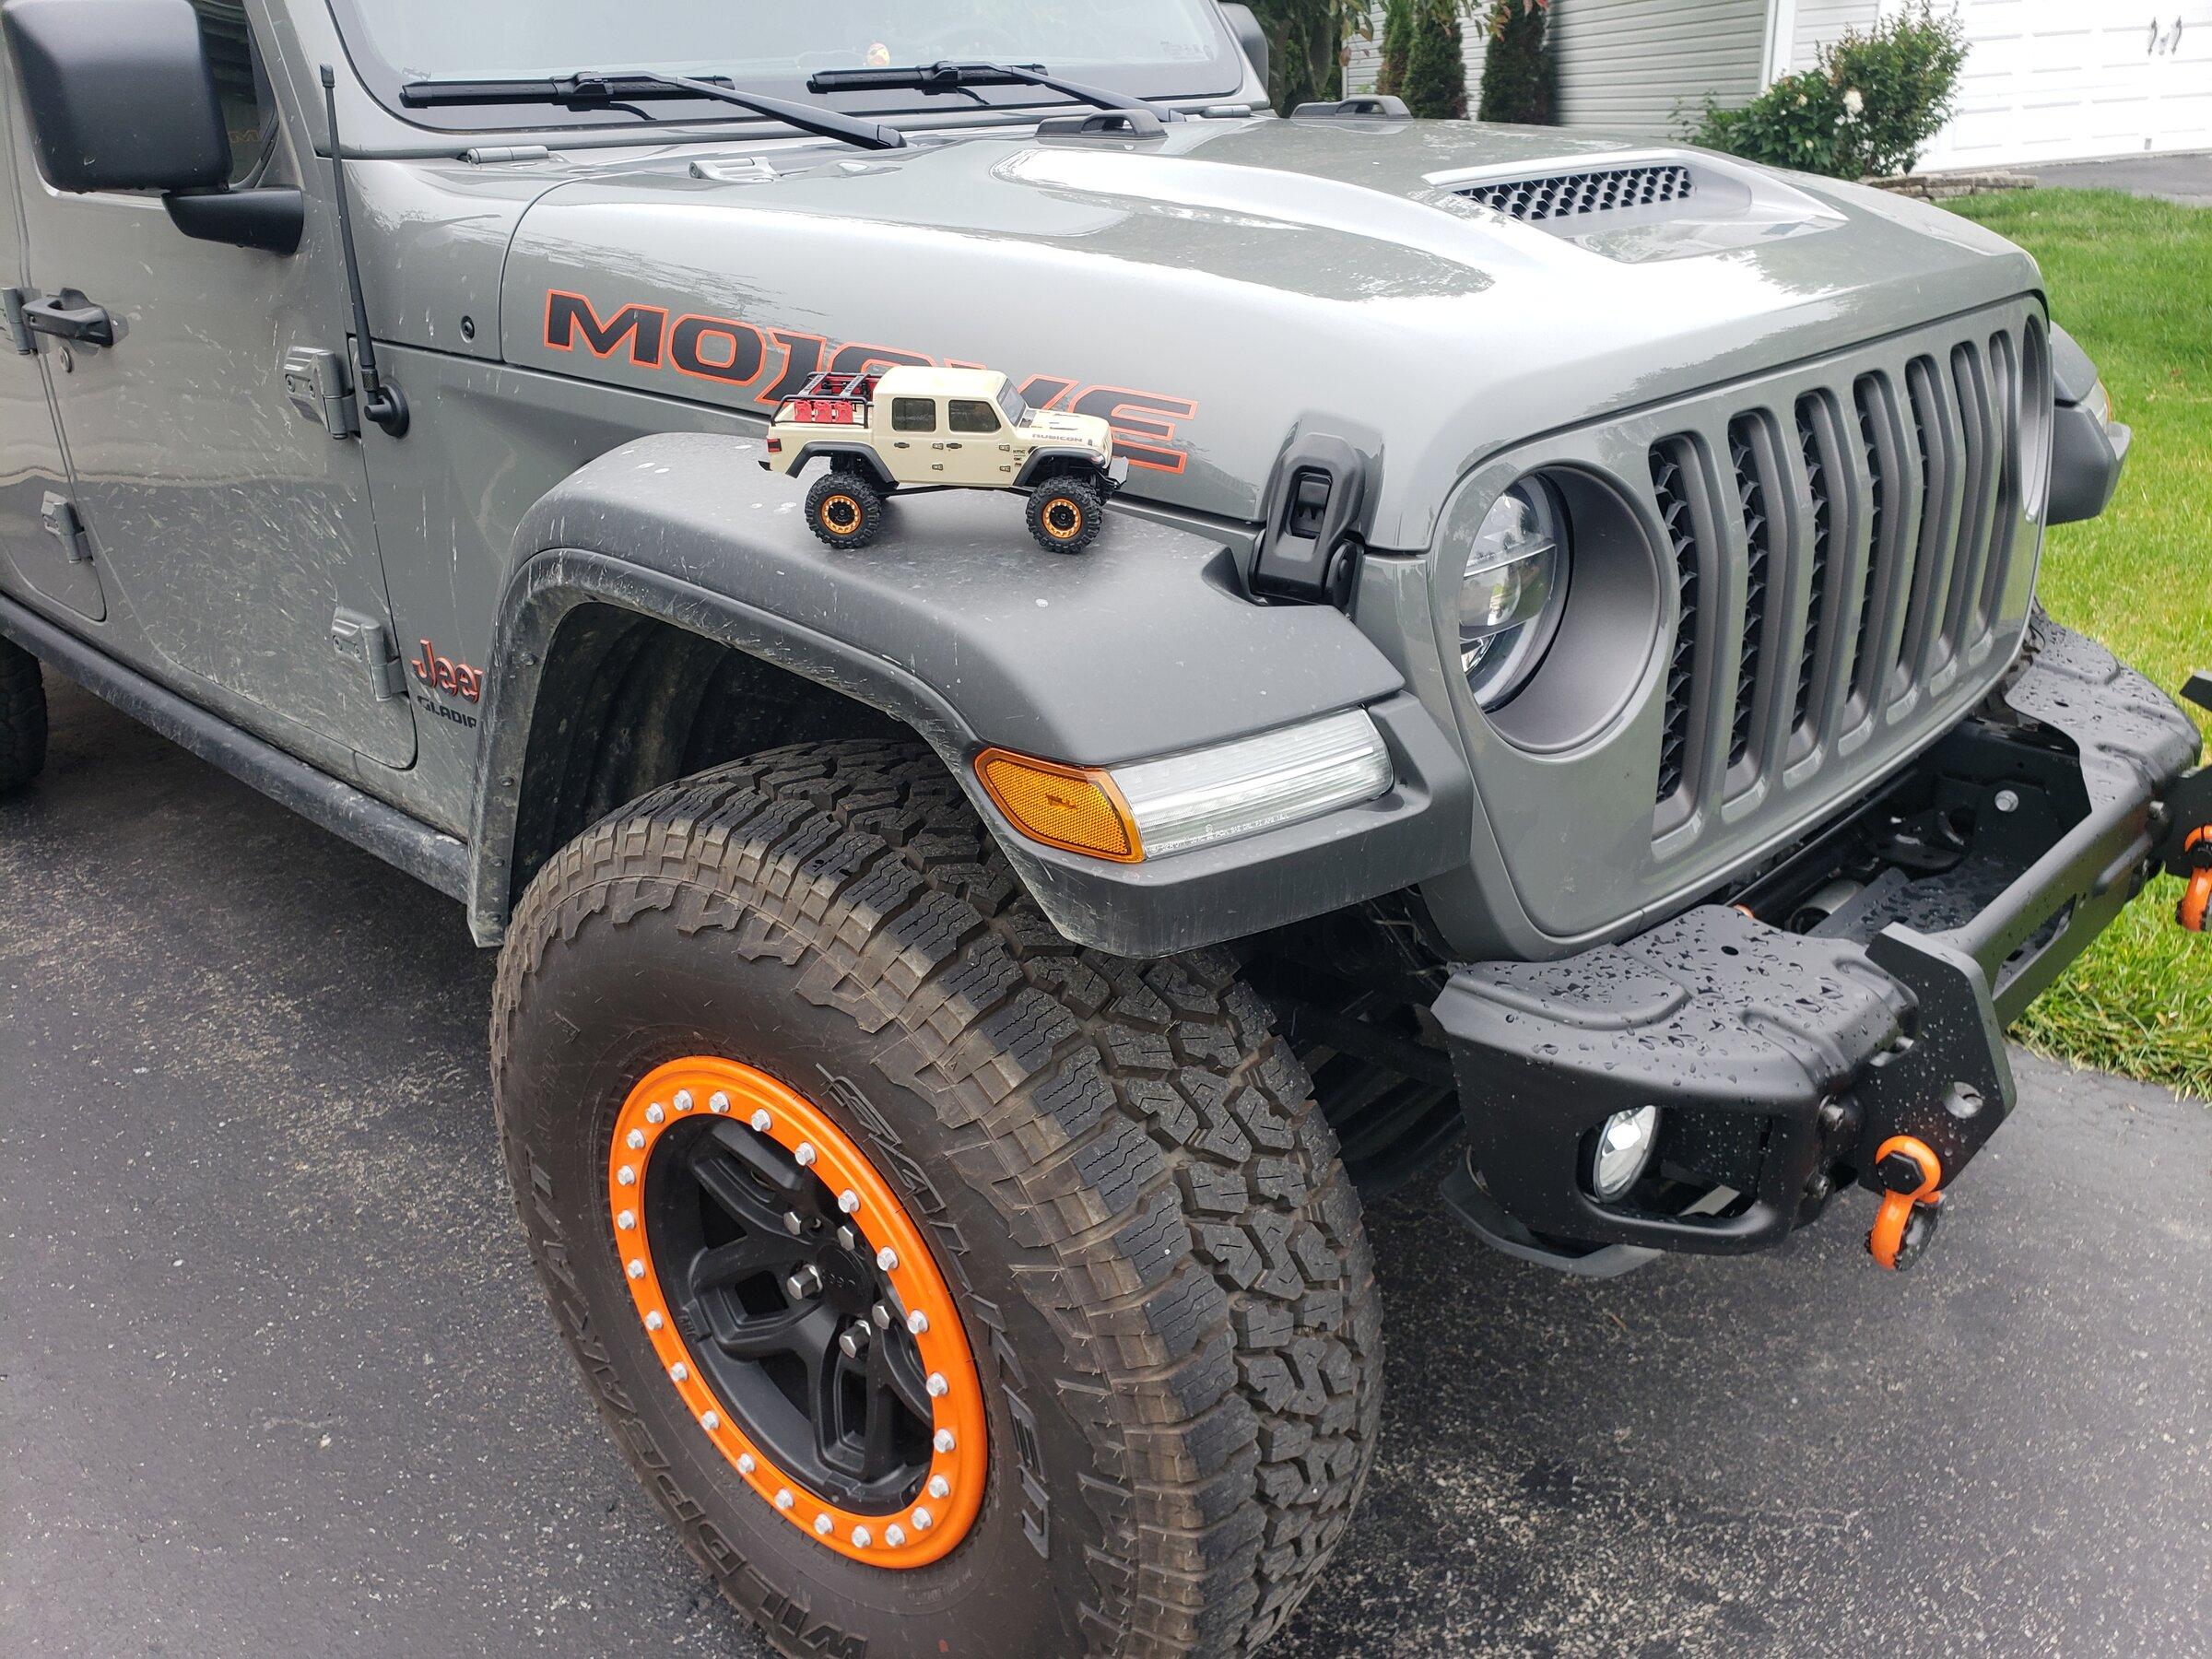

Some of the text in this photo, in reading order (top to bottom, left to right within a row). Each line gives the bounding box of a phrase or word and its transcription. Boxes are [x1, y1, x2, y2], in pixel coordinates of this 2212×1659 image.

[1031, 433, 1083, 442] RUBICON
[562, 1300, 868, 1659] WILDPEAK
[816, 1062, 1050, 1559] FALKEN
